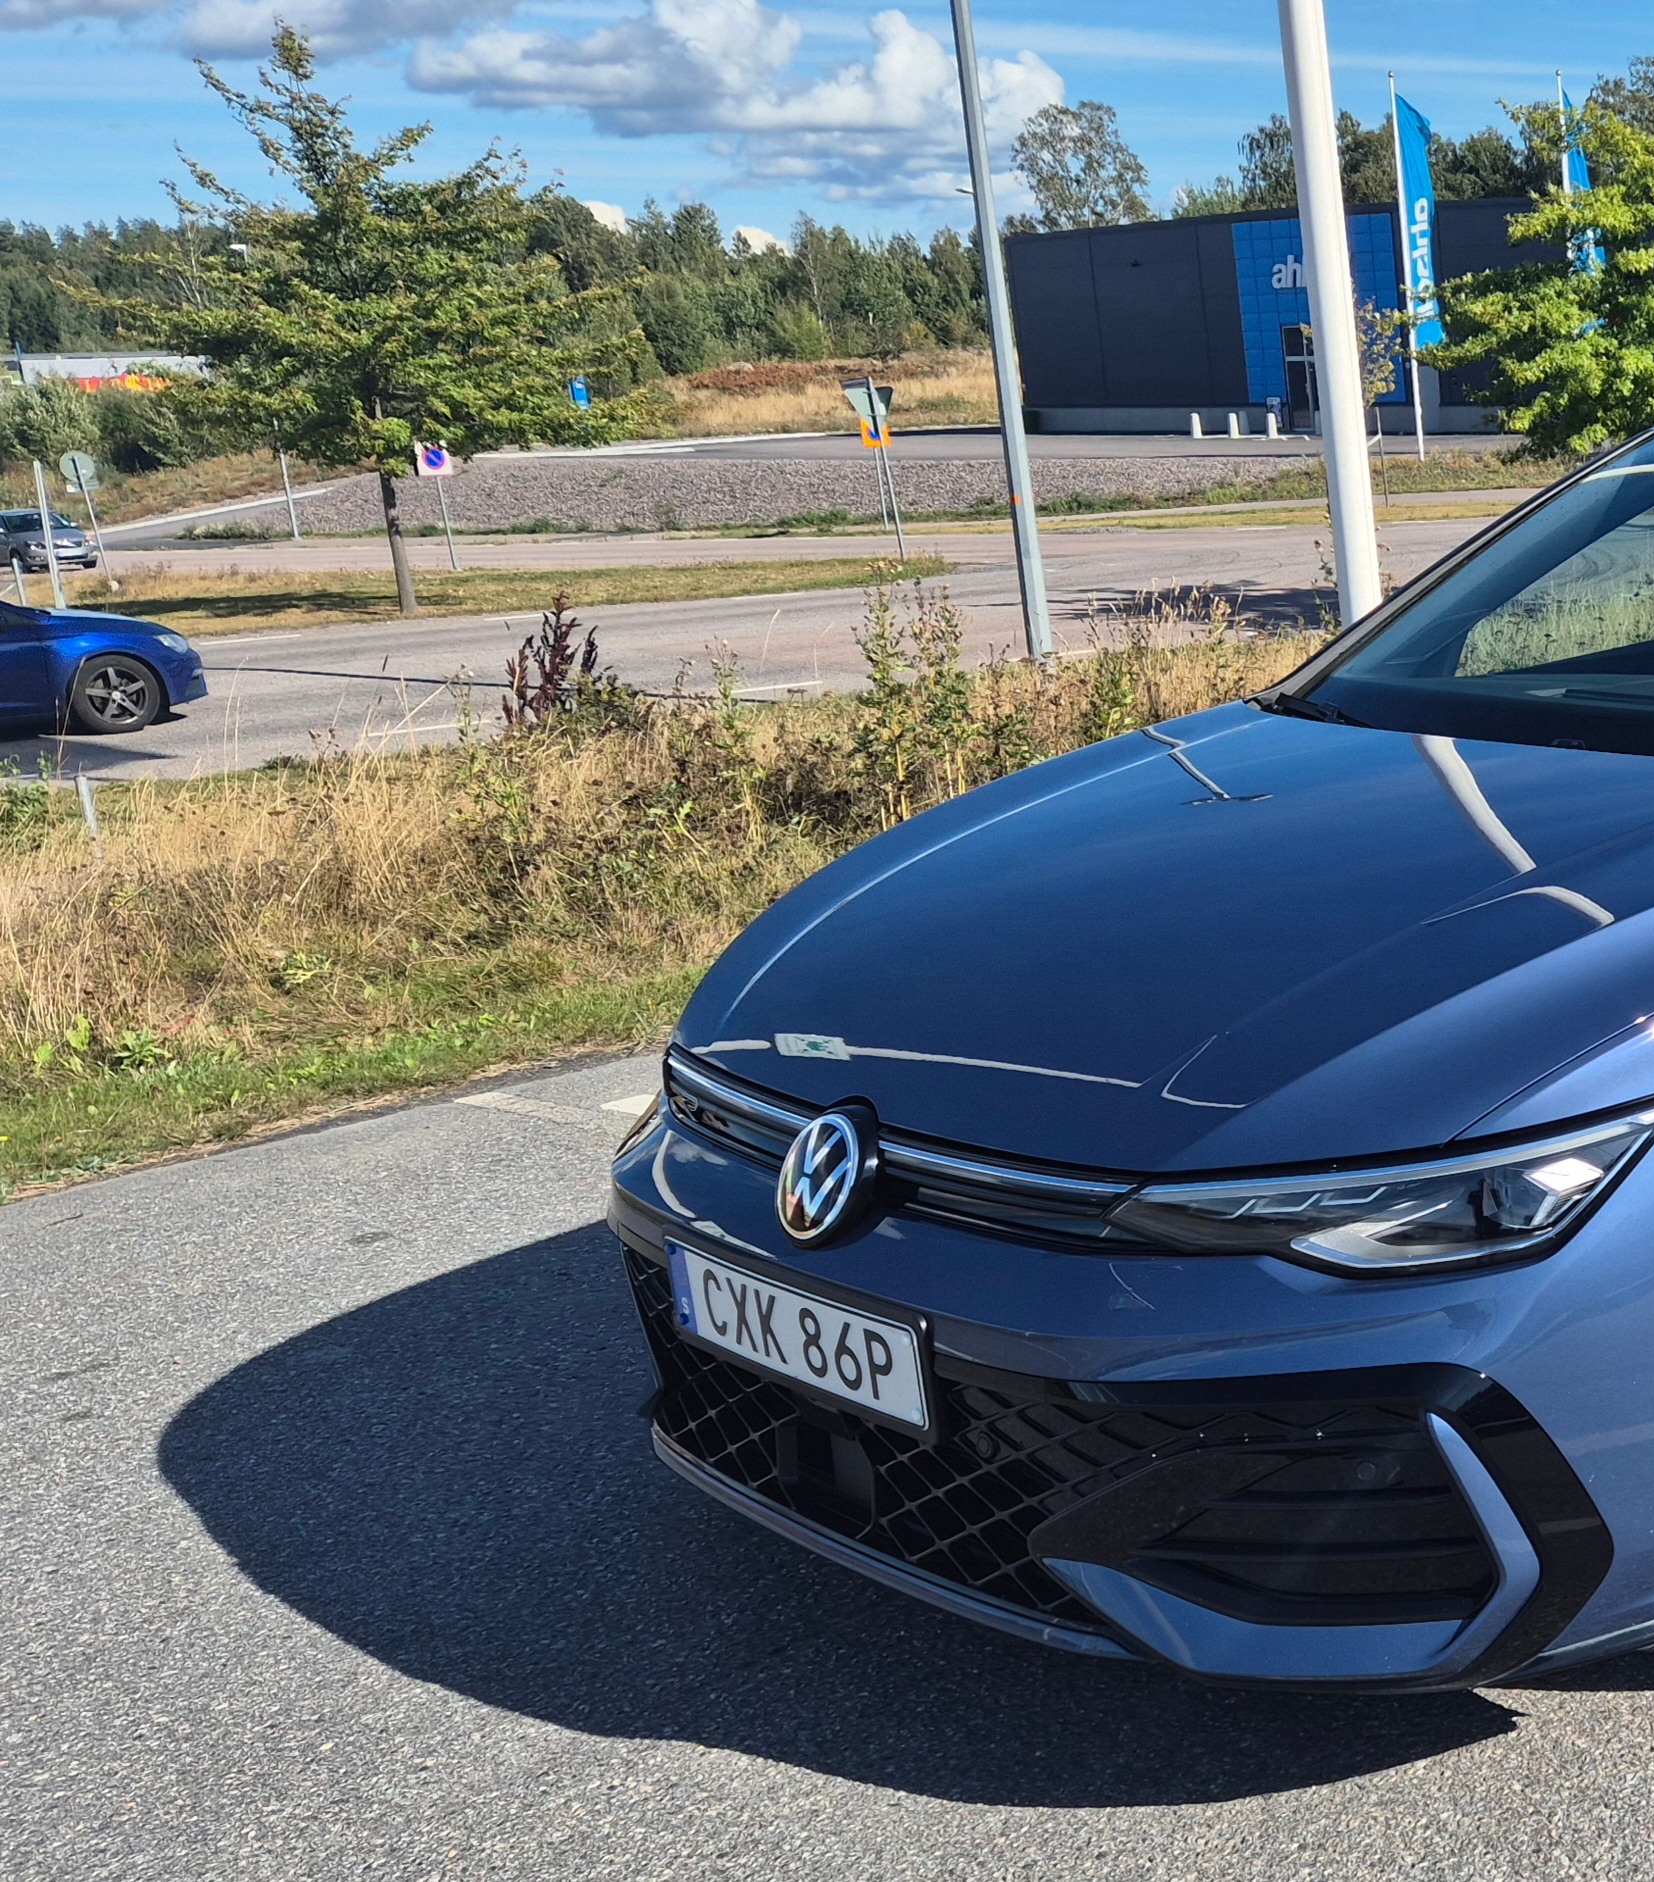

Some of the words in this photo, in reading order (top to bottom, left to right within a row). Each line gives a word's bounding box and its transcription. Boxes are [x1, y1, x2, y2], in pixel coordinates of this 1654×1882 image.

[681, 1297, 689, 1316] S
[702, 1268, 788, 1365] CXK
[798, 1307, 893, 1401] 86P
